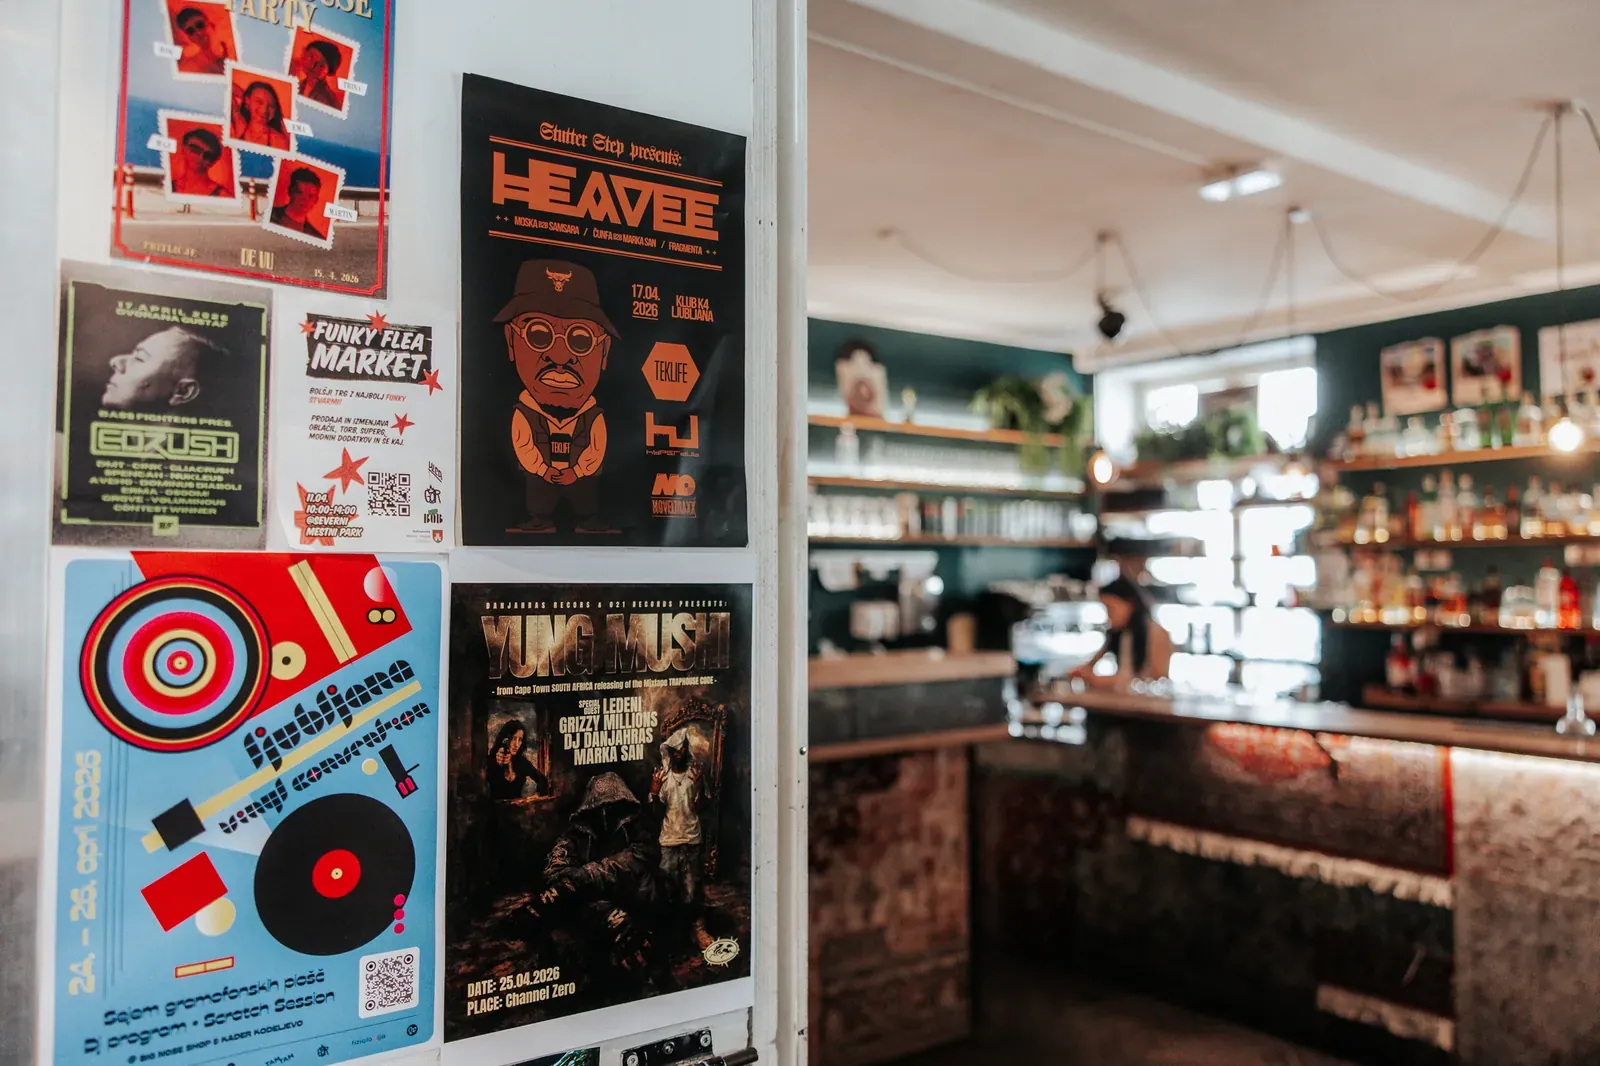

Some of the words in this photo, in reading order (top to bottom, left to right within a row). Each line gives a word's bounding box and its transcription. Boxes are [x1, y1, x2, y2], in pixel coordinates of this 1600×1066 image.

[540, 121, 588, 148] Stutter
[592, 133, 624, 158] Step
[629, 142, 683, 167] presents:
[492, 151, 720, 241] HEAVEE
[514, 215, 538, 229] MOSKA
[549, 221, 580, 235] SAMSARA
[240, 248, 256, 267] DE
[668, 241, 703, 256] FRAGMENTA
[340, 273, 359, 284] 2026
[631, 283, 661, 301] 17.04.
[675, 294, 697, 309] KLUB
[632, 300, 659, 317] 2026
[671, 305, 714, 323] LJUBLJANA
[313, 321, 378, 347] FUNKY
[380, 329, 425, 352] FLEA
[310, 342, 428, 380] MARKET
[654, 360, 688, 384] TEKLIFE
[335, 389, 348, 397] TRG
[355, 391, 385, 401] NAJBOLJ
[385, 393, 406, 403] FUNKY
[98, 409, 135, 421] BASS
[136, 411, 198, 425] FIGHTERS
[310, 414, 343, 424] PRODAJA
[352, 418, 389, 428] IZMENJAVA
[337, 434, 372, 444] DODATKOV
[306, 493, 329, 504] 11.04.
[306, 504, 357, 516] 10:00-14:00
[305, 527, 339, 537] MESTNI
[339, 527, 363, 537] PARK
[679, 600, 727, 608] PRESENTS:
[481, 613, 594, 680] YUNG
[605, 612, 731, 674] MUSHI
[496, 686, 514, 696] from
[514, 685, 532, 695] Cape
[532, 684, 551, 694] Town
[551, 682, 571, 693] SOUTH
[571, 681, 594, 692] AFRICA
[594, 680, 624, 690] releasing
[624, 679, 632, 688] of
[632, 679, 643, 688] the
[643, 678, 668, 688] Mixtape
[668, 676, 699, 687] TRAPHOUSE
[578, 699, 601, 709] SPECIAL
[602, 696, 643, 715] LEDENI
[583, 707, 601, 716] GUEST
[243, 659, 415, 773] ljubljana
[559, 714, 600, 735] GRIZZY
[603, 711, 658, 731] MILLIONS
[563, 733, 581, 750] DJ
[583, 727, 654, 749] DANJAHRAS
[573, 746, 618, 766] MARKA
[620, 743, 645, 762] SAN
[218, 778, 289, 834] vinyl
[291, 702, 431, 792] convention
[73, 749, 101, 819] 2026
[467, 979, 497, 999] DATE:
[499, 966, 561, 992] 25.04.2026
[466, 995, 504, 1017] PLACE:
[505, 985, 550, 1008] Channel
[551, 981, 576, 999] Zero
[107, 1020, 187, 1050] program
[274, 990, 335, 1013] Session
[221, 1030, 252, 1044] KADER
[253, 1019, 304, 1036] KODELJEVO
